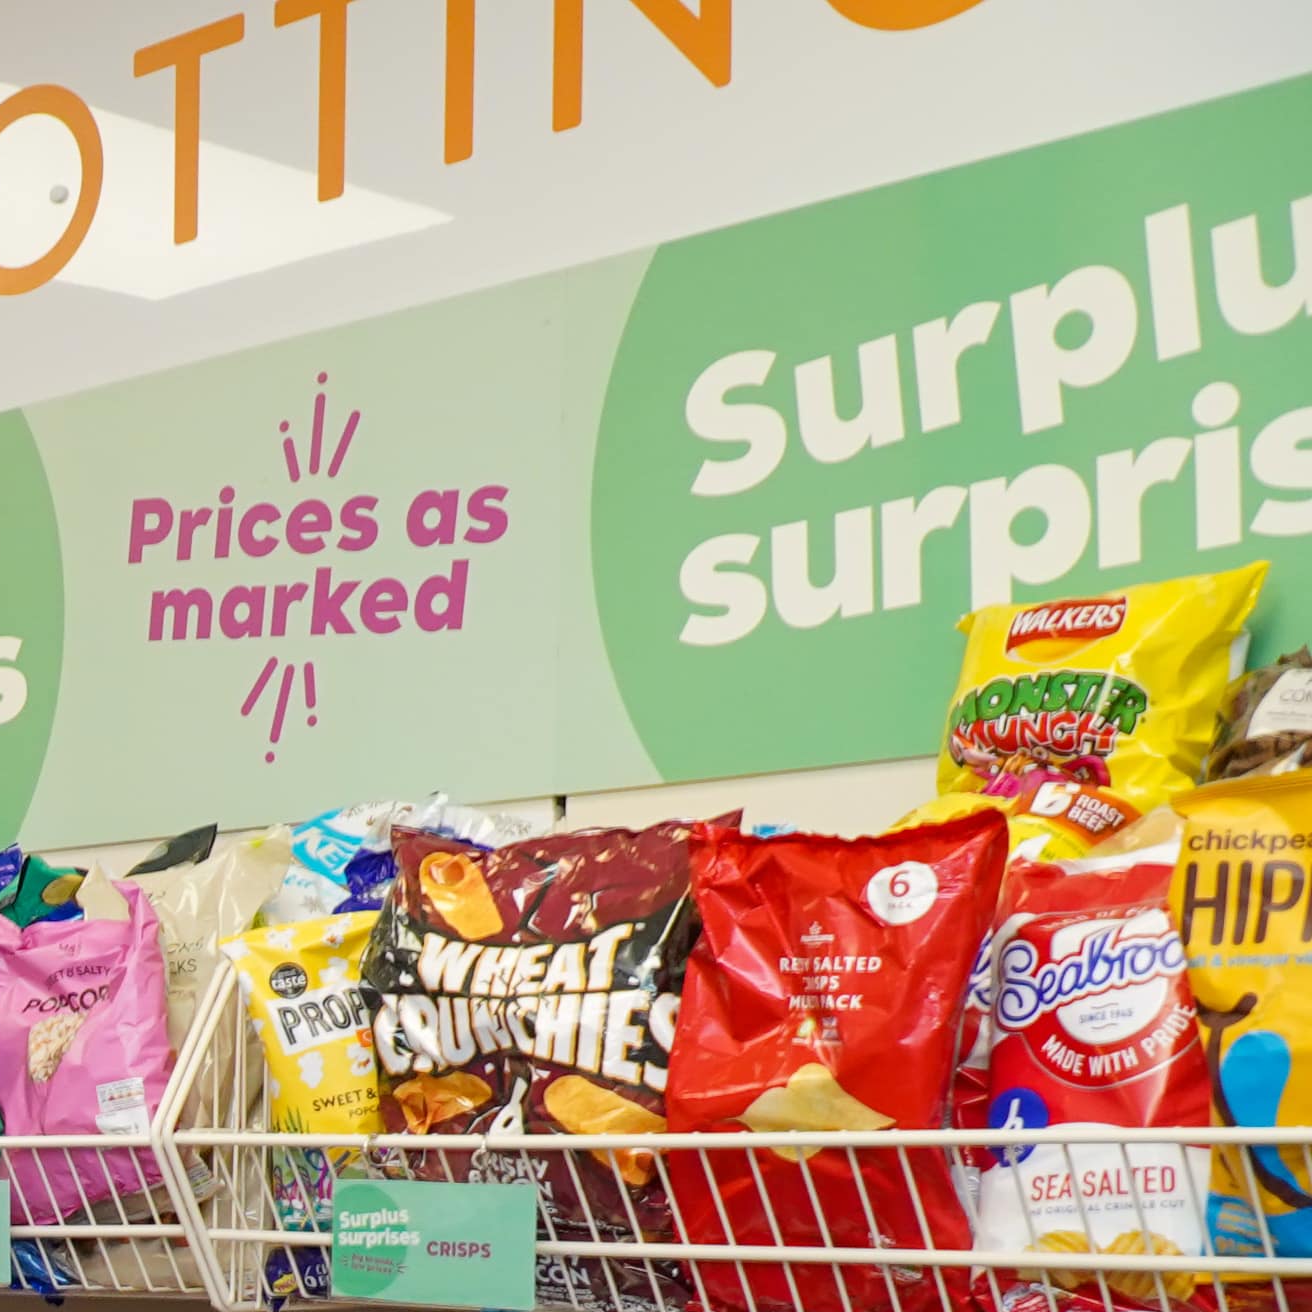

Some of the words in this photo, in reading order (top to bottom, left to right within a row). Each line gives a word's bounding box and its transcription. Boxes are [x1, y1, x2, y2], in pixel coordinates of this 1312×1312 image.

[127, 486, 379, 566] Prices
[406, 484, 509, 548] as
[147, 560, 470, 643] marked
[1012, 603, 1125, 636] WALKERS
[953, 670, 1148, 735] MONSTER
[951, 711, 1117, 766] MUNCH
[1067, 808, 1108, 833] BEEF
[1076, 794, 1125, 827] ROAST
[889, 869, 911, 898] 6
[417, 921, 635, 998] WHEAT
[813, 956, 882, 973] SALTED
[998, 928, 1185, 1024] Seabroo
[373, 989, 681, 1094] CRUNCHIES
[1041, 1033, 1085, 1077] MADE
[1089, 1046, 1140, 1077] WITH
[1141, 1002, 1198, 1059] PRIDE
[312, 1089, 363, 1112] SWEET
[366, 1087, 378, 1100] &
[1031, 1170, 1073, 1202] SEA
[338, 1207, 410, 1230] Surplus
[337, 1226, 422, 1249] surprises
[426, 1240, 492, 1259] CRISPS
